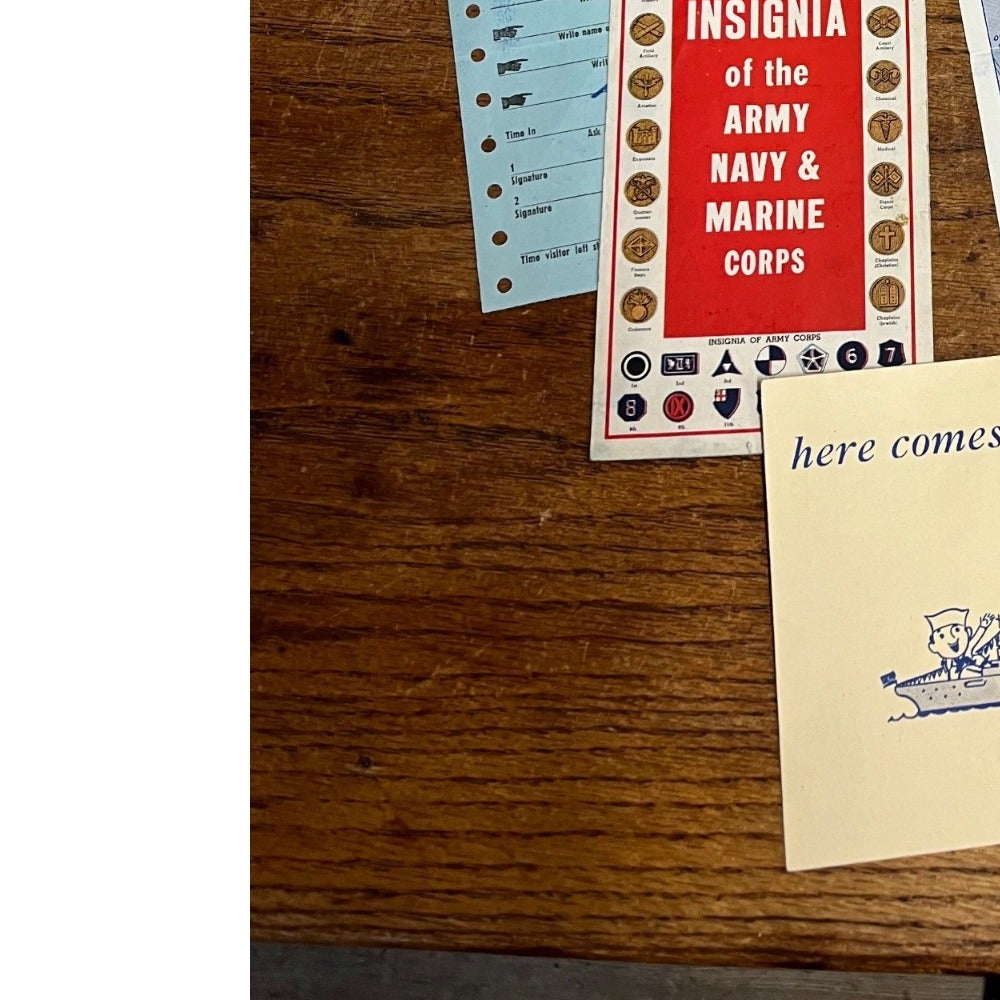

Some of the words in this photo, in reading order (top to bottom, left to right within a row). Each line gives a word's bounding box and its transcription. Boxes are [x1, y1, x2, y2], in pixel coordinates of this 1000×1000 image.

[558, 31, 579, 40] Write
[582, 27, 602, 36] name
[725, 58, 752, 87] of
[765, 58, 809, 86] the
[724, 103, 809, 135] ARMY
[505, 131, 524, 139] Time
[710, 151, 785, 183] NAVY
[798, 150, 819, 181] &
[512, 172, 548, 185] Signature
[515, 205, 552, 219] Signature
[705, 199, 825, 233] MARINE
[521, 256, 540, 264] Time
[546, 249, 569, 259] visitor
[724, 248, 805, 276] CORPS
[709, 337, 746, 346] INSIGNIA
[750, 336, 762, 344] OF
[766, 335, 790, 343] ARMY
[794, 334, 821, 342] CORPS
[846, 348, 857, 363] 6
[886, 347, 896, 362] 7
[626, 400, 636, 416] 8
[791, 436, 875, 470] here
